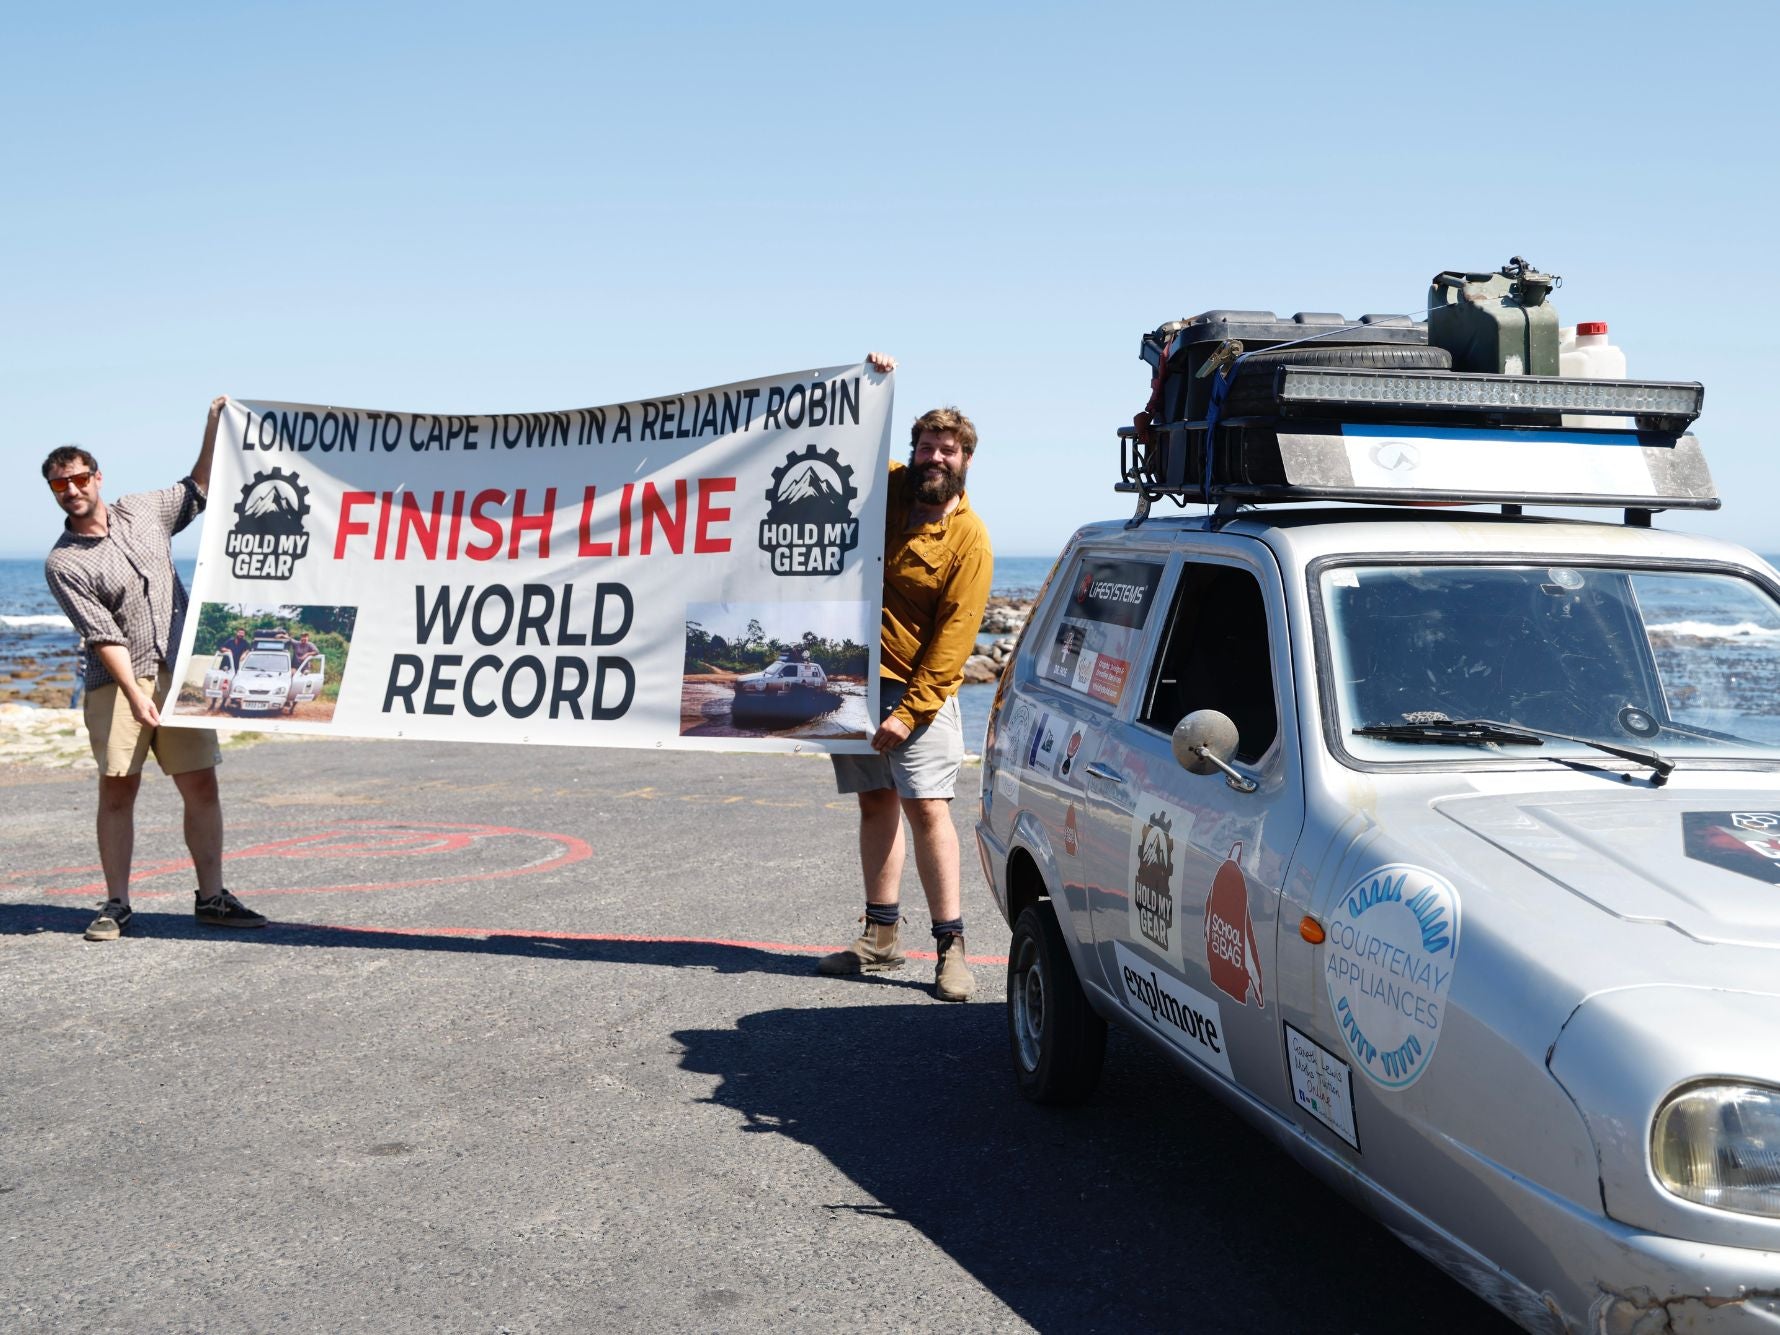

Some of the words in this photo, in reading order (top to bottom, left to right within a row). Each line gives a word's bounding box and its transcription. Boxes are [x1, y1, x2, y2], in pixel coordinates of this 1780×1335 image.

[242, 410, 359, 452] LONDON
[366, 412, 402, 452] TO
[409, 414, 479, 451] CAPE
[489, 413, 571, 449] TOWN
[578, 408, 606, 445] IN
[611, 404, 632, 443] A
[640, 388, 761, 441] RELIANT
[763, 377, 861, 431] ROBIN
[333, 487, 557, 561] FINISH
[578, 477, 737, 558] LINE
[763, 522, 818, 546] HOLD
[823, 521, 857, 545] MY
[227, 533, 275, 554] HOLD
[278, 533, 308, 553] MY
[774, 546, 841, 573] GEAR
[234, 554, 294, 577] GEAR
[415, 582, 635, 646] WORLD
[382, 653, 636, 721] RECORD
[1136, 881, 1157, 912] HOLD
[1158, 893, 1171, 921] MY
[1140, 907, 1168, 946] GEAR
[1211, 929, 1220, 944] in
[1212, 913, 1242, 947] SCHOOL
[1212, 941, 1220, 955] a
[1330, 920, 1449, 994] COURTENAY
[1123, 964, 1221, 1054] explmore
[1327, 952, 1438, 1030] APPLIANCES
